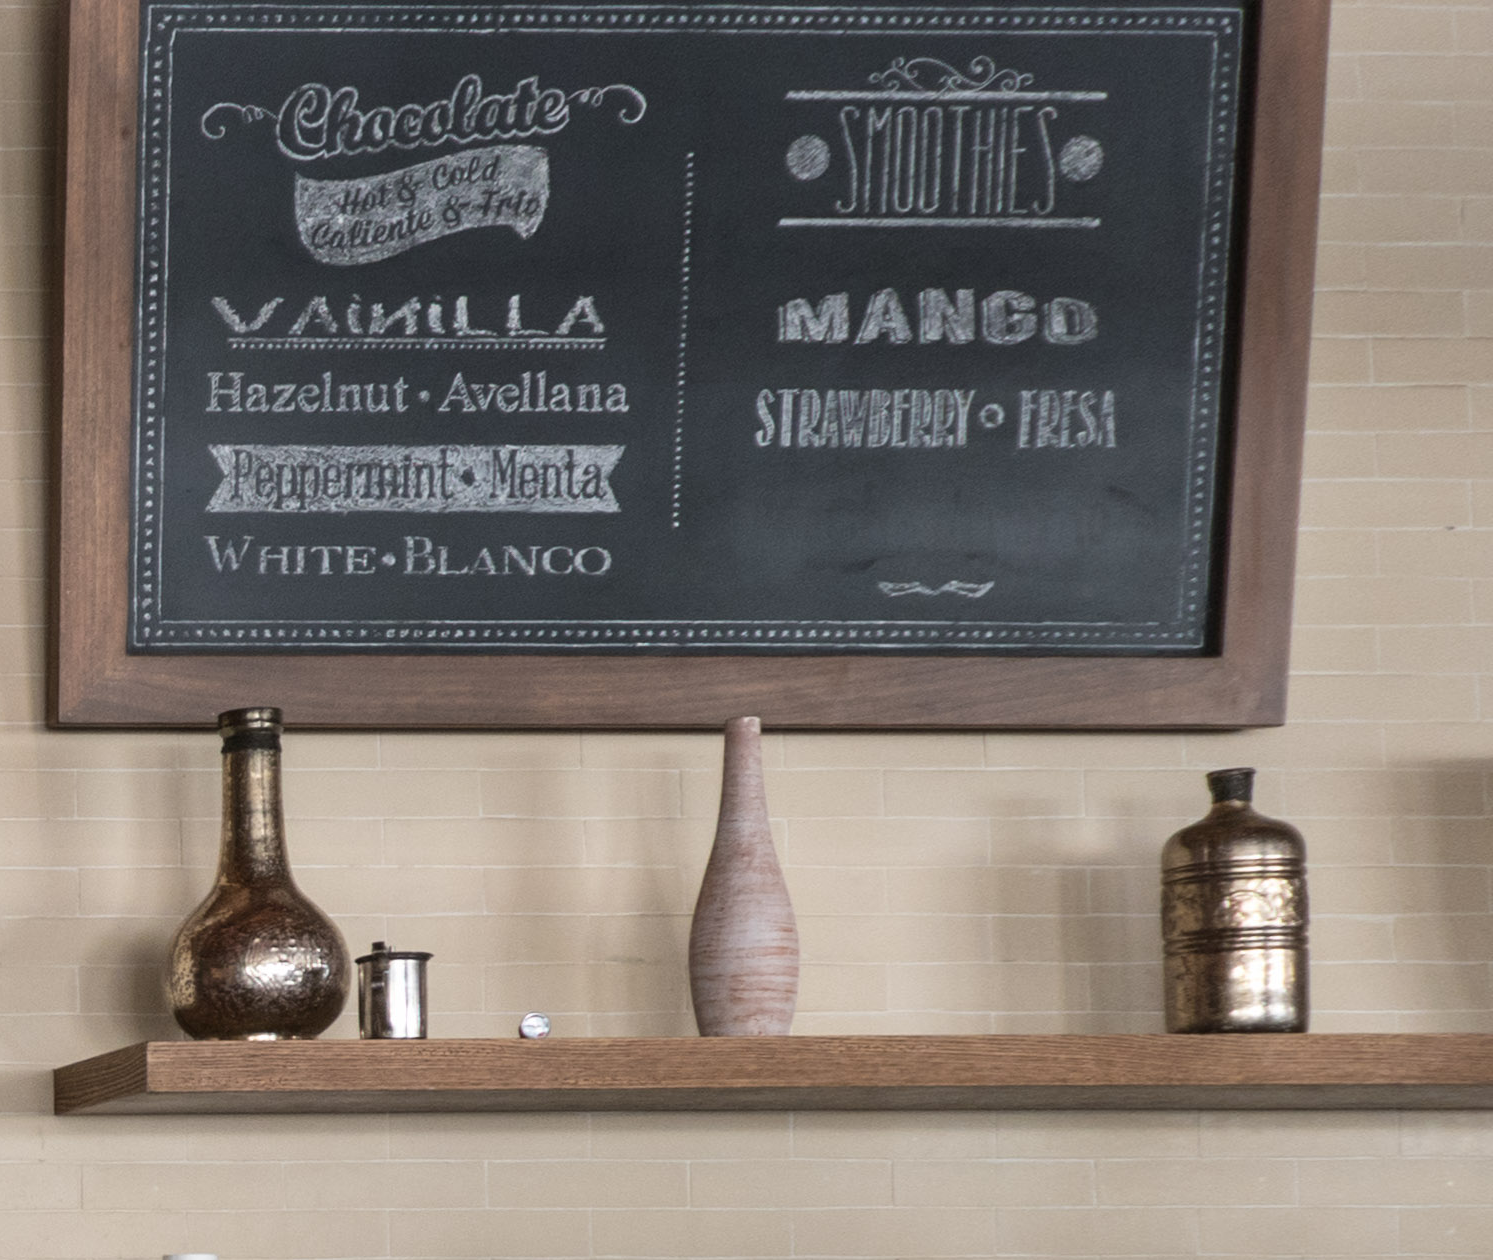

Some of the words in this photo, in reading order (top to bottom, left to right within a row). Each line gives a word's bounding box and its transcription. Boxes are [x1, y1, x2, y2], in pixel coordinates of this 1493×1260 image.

[275, 73, 572, 161] Chocolate
[334, 185, 390, 216] Hot
[397, 174, 423, 208] &
[432, 155, 501, 191] Cold
[835, 105, 1059, 216] SMOOTHIES
[312, 211, 434, 249] Caliente
[442, 196, 470, 228] &
[776, 287, 1099, 345] MANGO
[205, 371, 409, 413] Hazelnut
[438, 370, 630, 414] Avellana
[755, 387, 976, 449] STRAWBERRY
[1017, 389, 1117, 449] FRESA
[230, 447, 455, 510] Peppermint
[490, 447, 610, 501] Menta
[204, 534, 378, 576] WHITE
[403, 535, 613, 577] BLANCO
